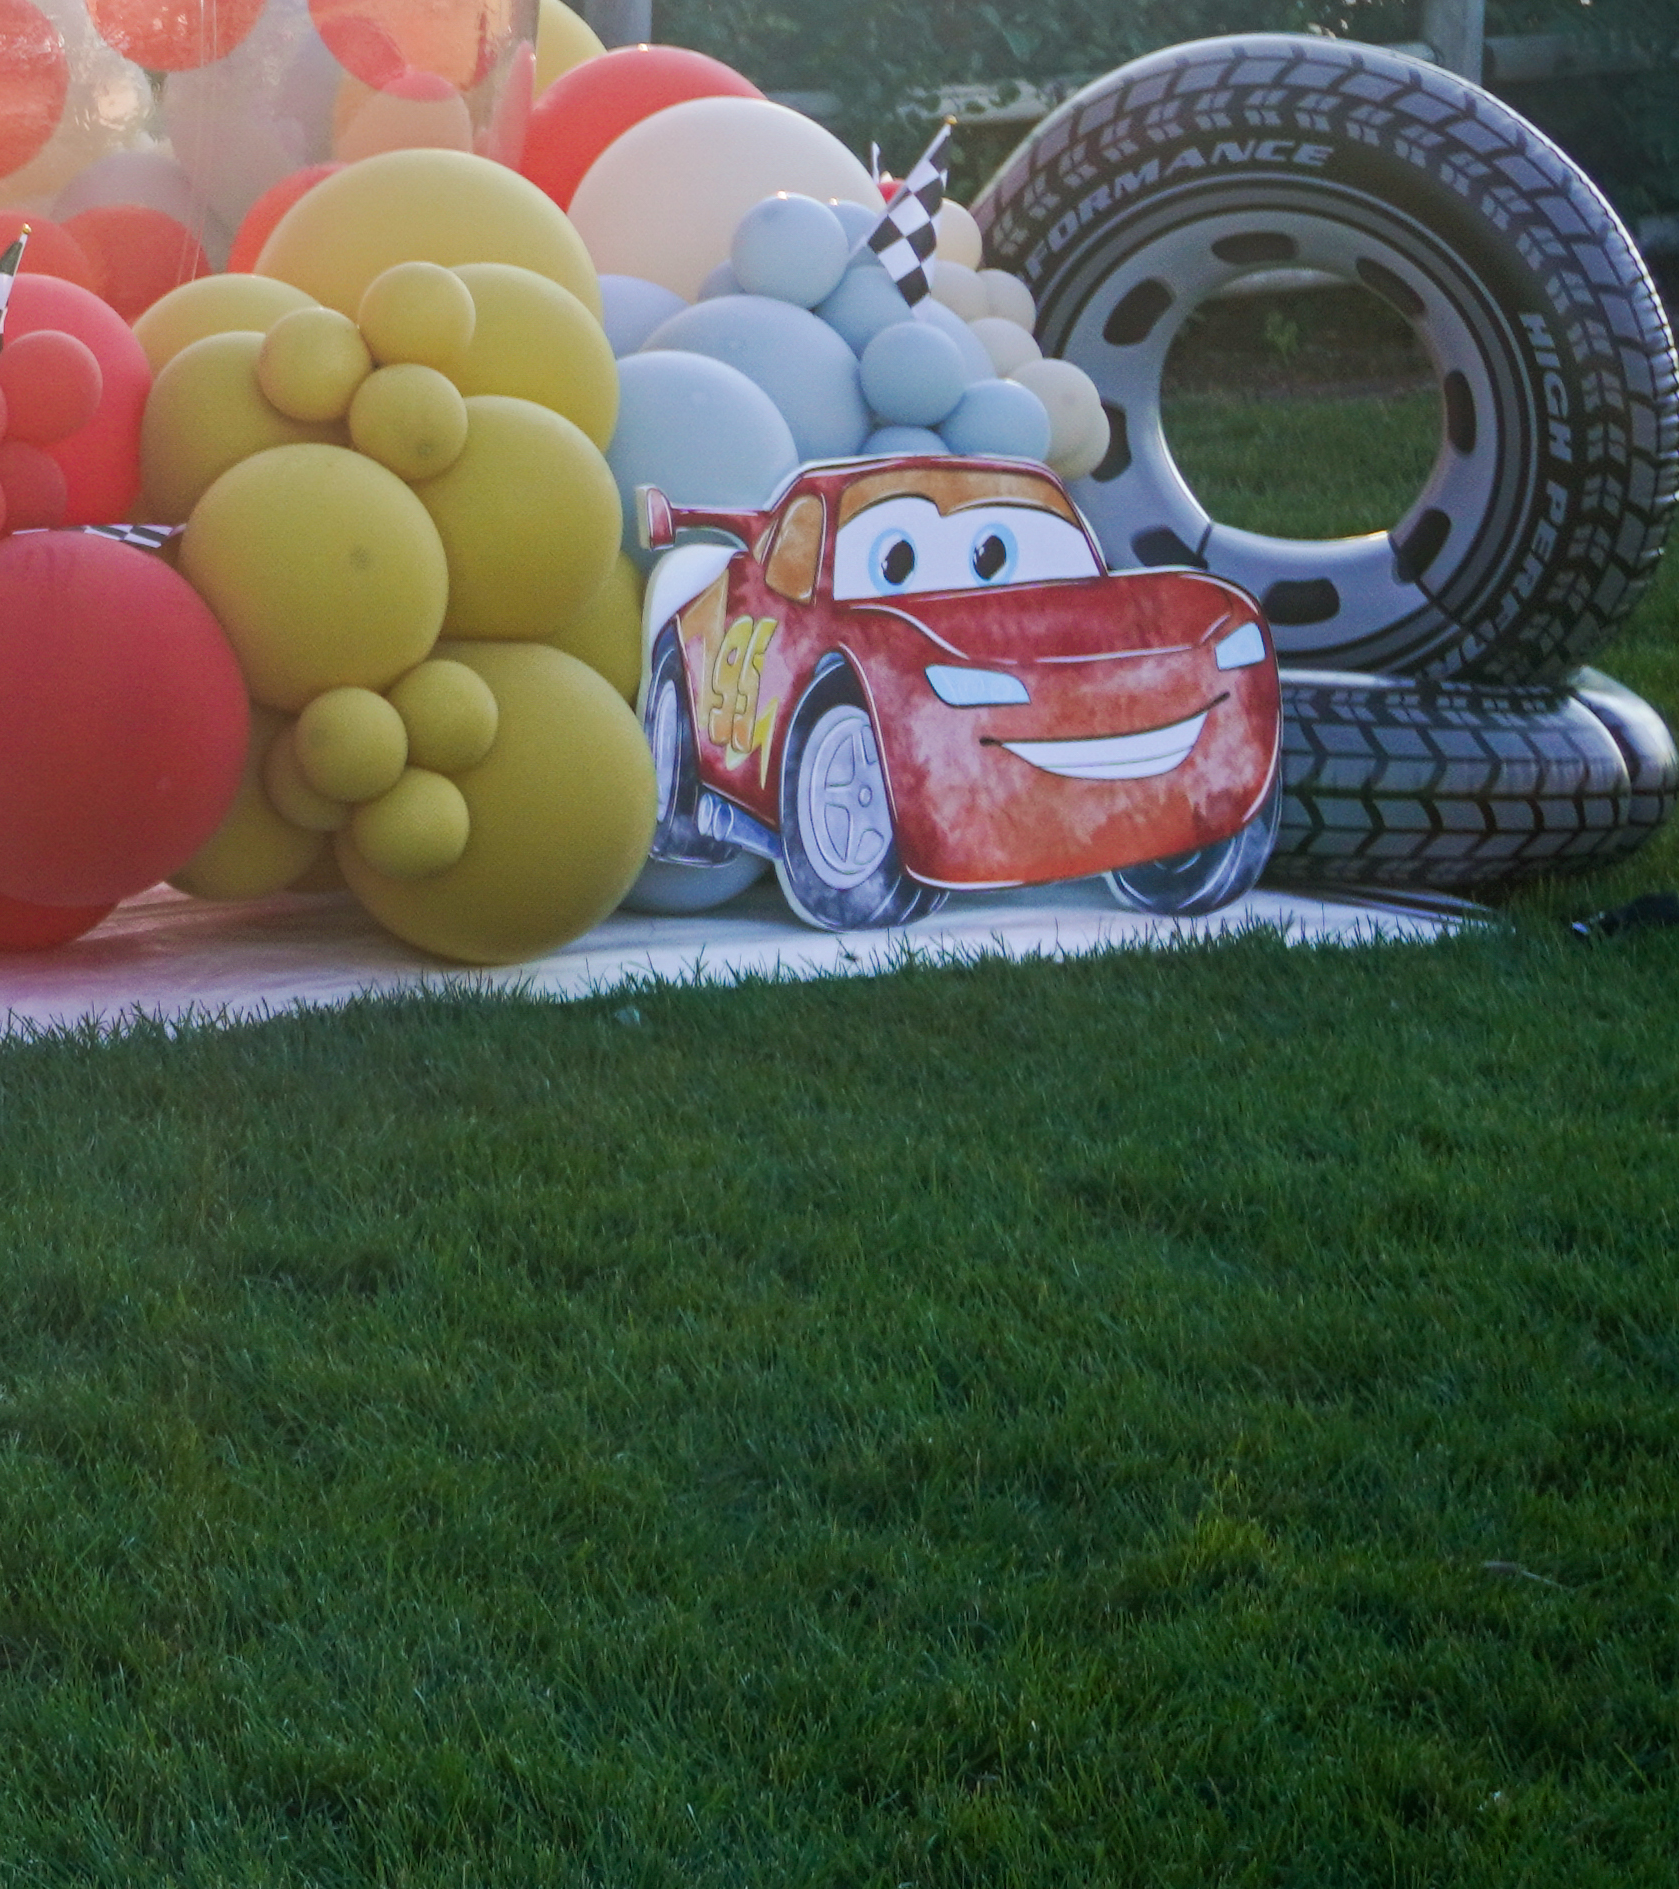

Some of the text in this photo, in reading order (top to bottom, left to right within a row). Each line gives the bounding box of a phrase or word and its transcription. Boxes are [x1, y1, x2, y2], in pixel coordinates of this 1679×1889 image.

[1016, 139, 1334, 293] FORMANCE
[1520, 313, 1573, 464] HIGH
[708, 615, 778, 754] 95
